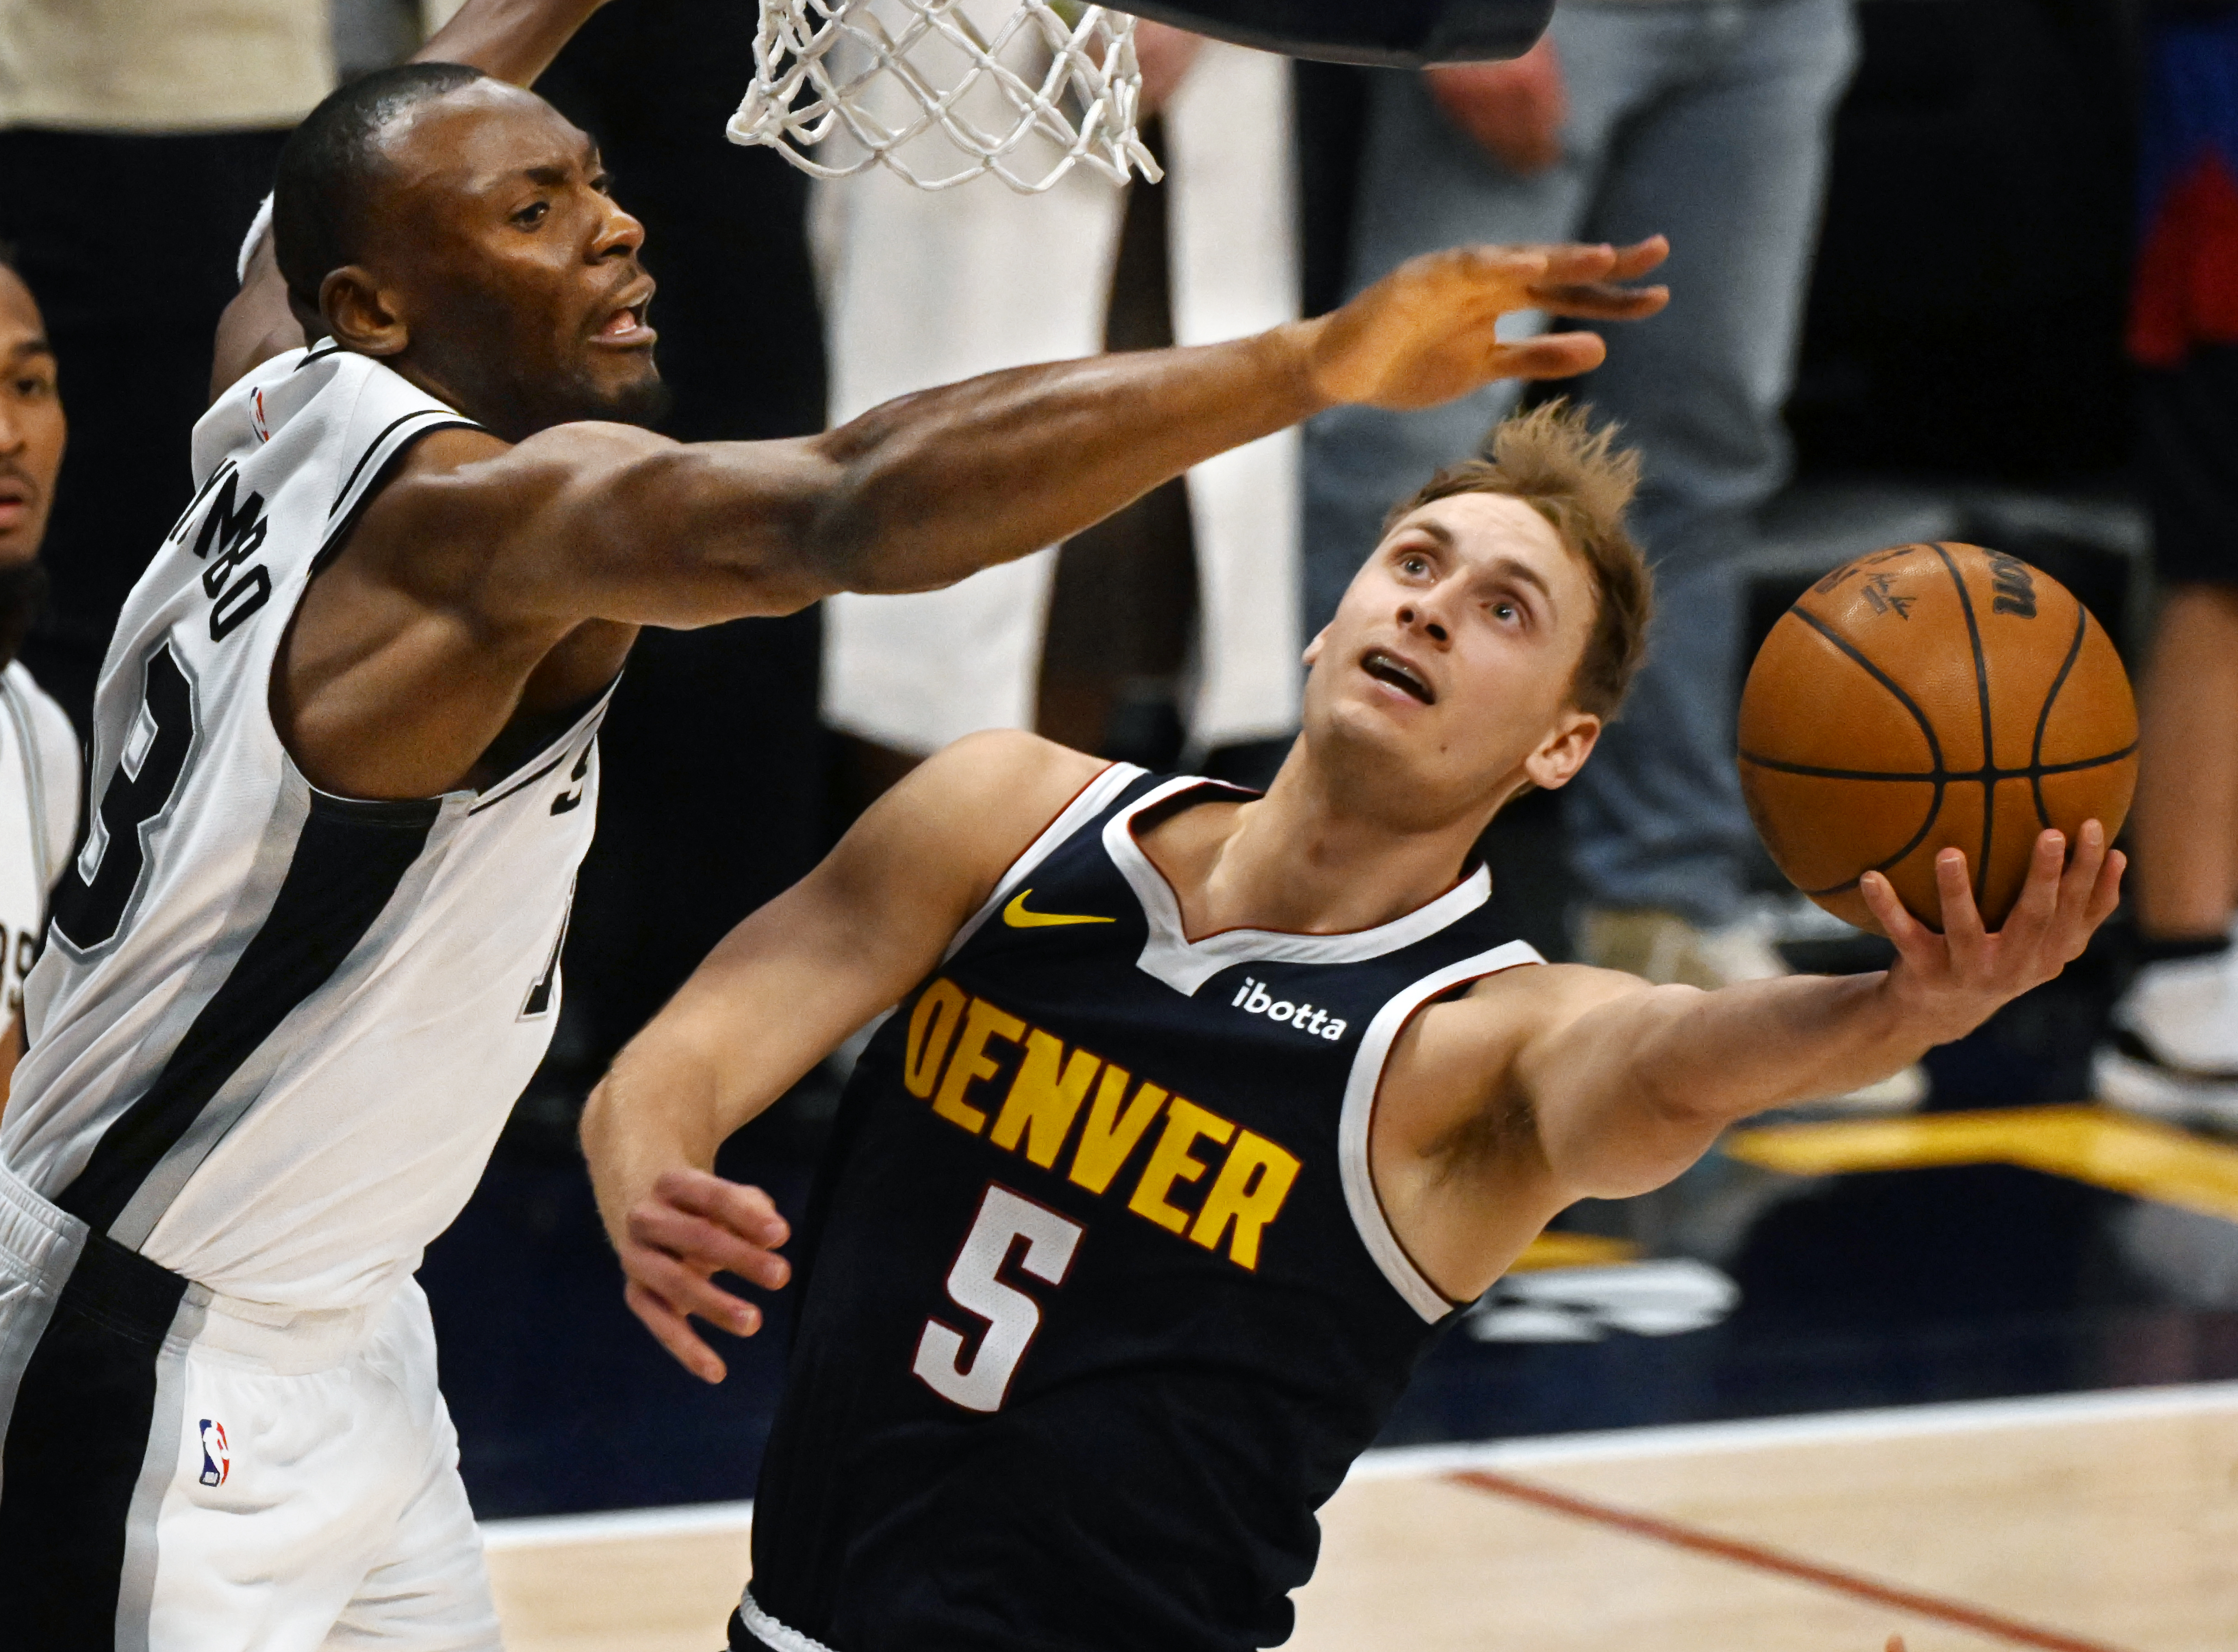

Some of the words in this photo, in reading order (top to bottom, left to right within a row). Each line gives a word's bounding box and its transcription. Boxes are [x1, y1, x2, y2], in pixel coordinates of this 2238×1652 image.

[904, 976, 1304, 1271] DENVER
[1230, 976, 1348, 1041] ibotta
[910, 1178, 1086, 1413] 5
